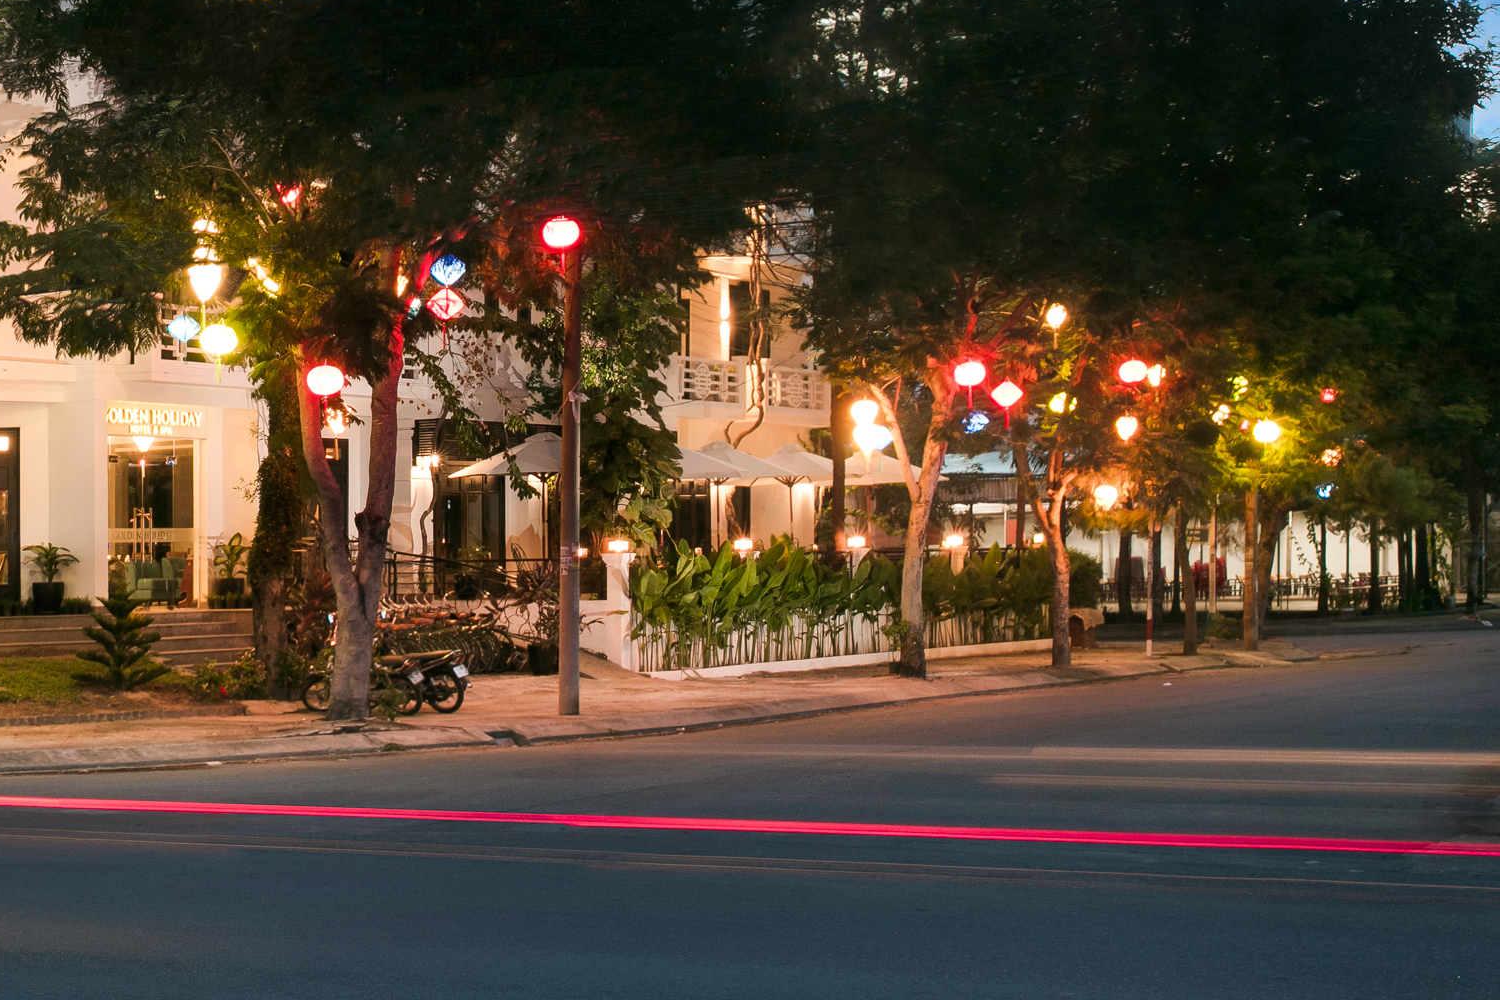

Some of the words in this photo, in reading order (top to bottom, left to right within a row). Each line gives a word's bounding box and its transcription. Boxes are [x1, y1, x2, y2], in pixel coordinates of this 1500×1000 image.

[151, 409, 203, 426] HOLIDAY
[129, 424, 151, 434] HOTEL
[159, 425, 173, 435] SPA
